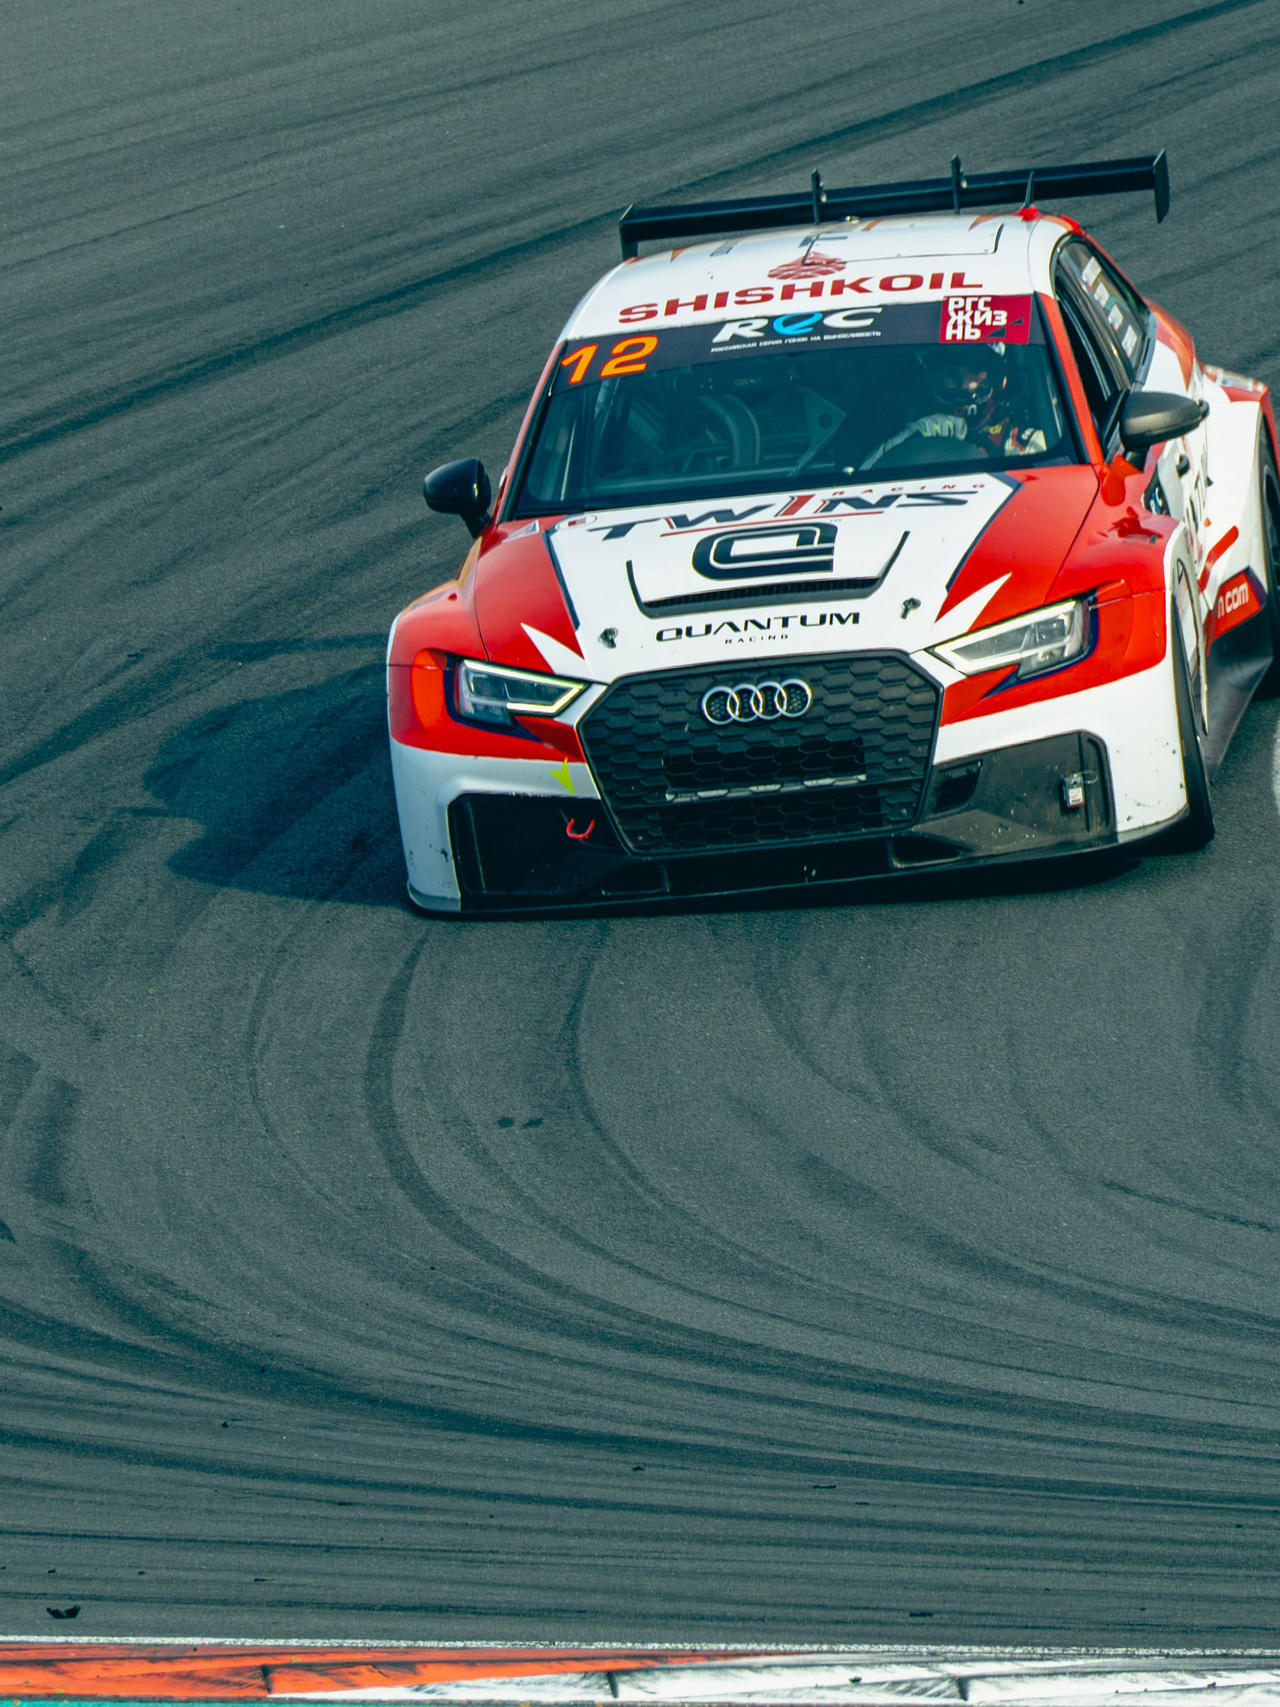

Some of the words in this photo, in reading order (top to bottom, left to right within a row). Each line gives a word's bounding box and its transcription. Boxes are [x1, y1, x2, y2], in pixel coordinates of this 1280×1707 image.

[618, 272, 983, 324] SHISHKOIL
[947, 296, 993, 312] РГС
[561, 334, 659, 385] 12
[831, 483, 985, 497] RACING
[586, 490, 979, 541] TWINS
[655, 611, 861, 643] QUANTUM
[724, 633, 790, 645] RACING
